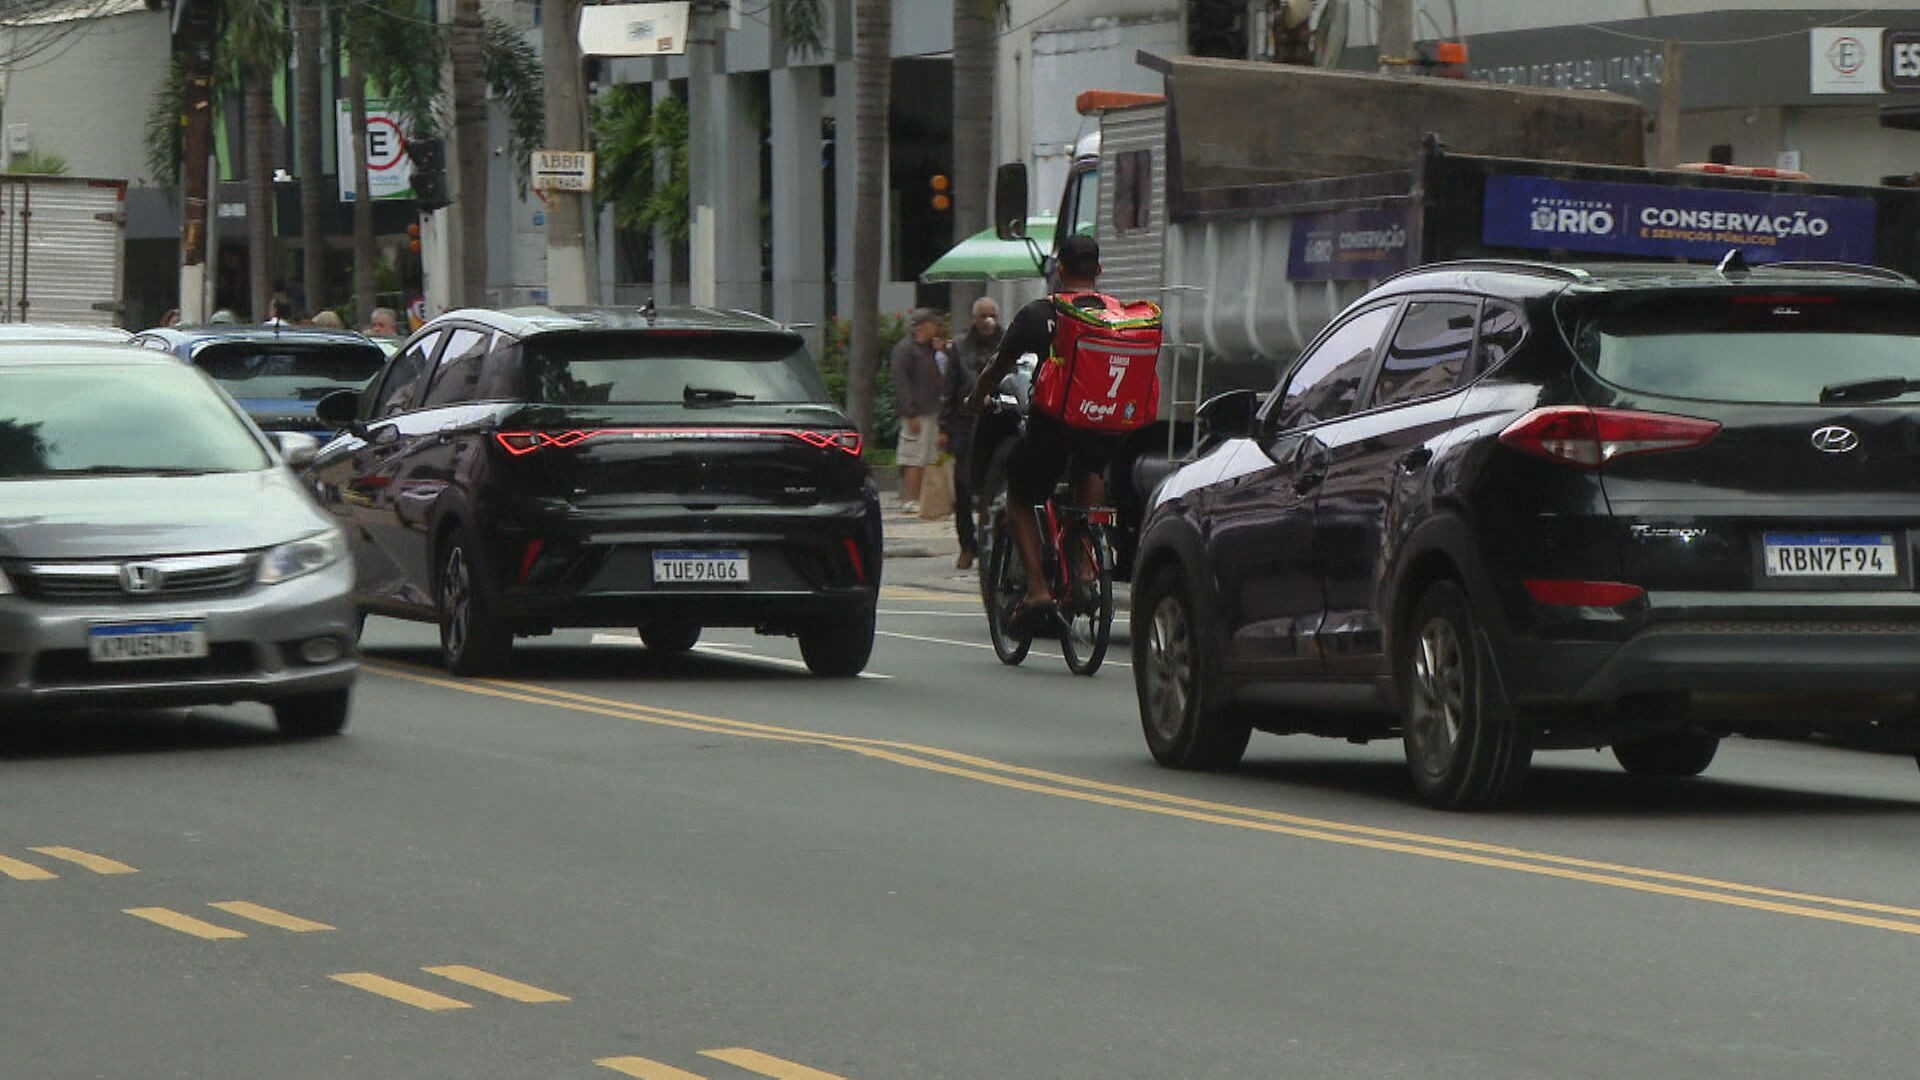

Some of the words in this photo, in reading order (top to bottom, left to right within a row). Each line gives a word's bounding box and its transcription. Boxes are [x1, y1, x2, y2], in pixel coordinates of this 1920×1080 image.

[1839, 43, 1854, 68] E
[368, 131, 388, 156] E
[1531, 197, 1613, 209] PREFEITURA
[1557, 208, 1615, 235] RIO
[1640, 206, 1829, 239] CONSERVAÇÃO
[1651, 229, 1713, 242] SERVIÇOS
[1714, 231, 1777, 246] PÚBLICOS
[1106, 367, 1126, 398] 7
[1778, 547, 1882, 571] RBN7F94
